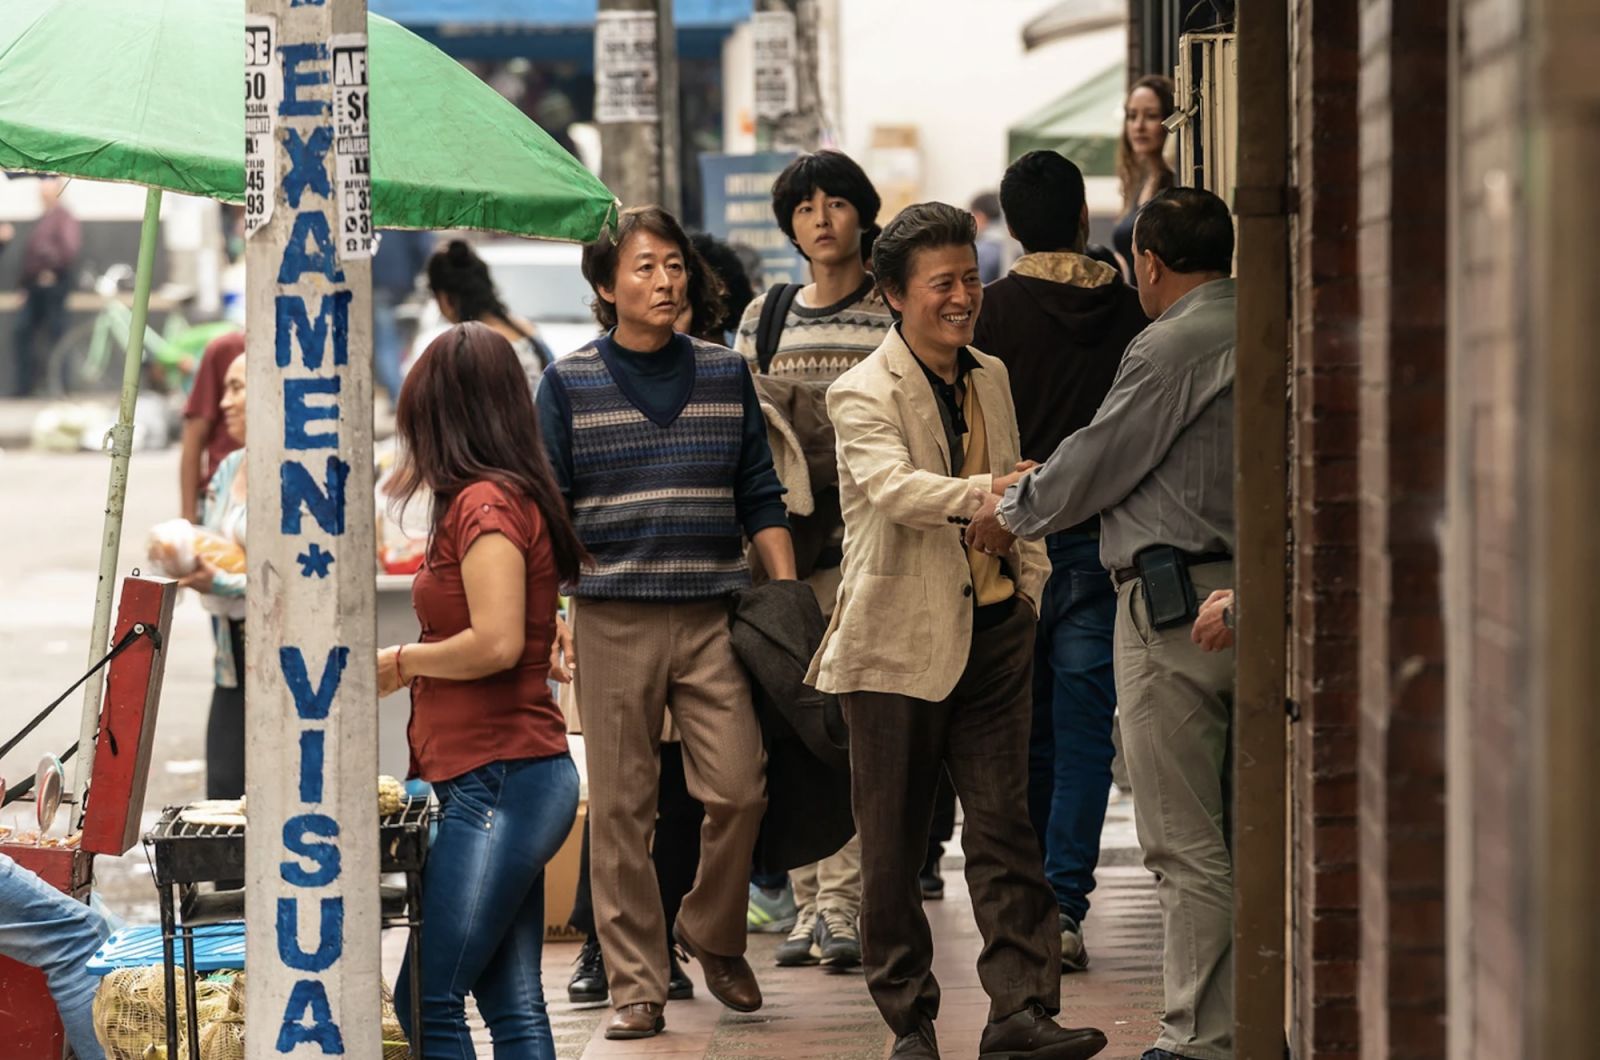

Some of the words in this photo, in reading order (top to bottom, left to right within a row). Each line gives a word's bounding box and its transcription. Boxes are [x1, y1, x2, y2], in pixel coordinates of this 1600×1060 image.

[247, 194, 264, 214] 93
[248, 170, 264, 190] 45
[275, 43, 352, 536] EXAMEN
[276, 646, 350, 1055] VISUA
